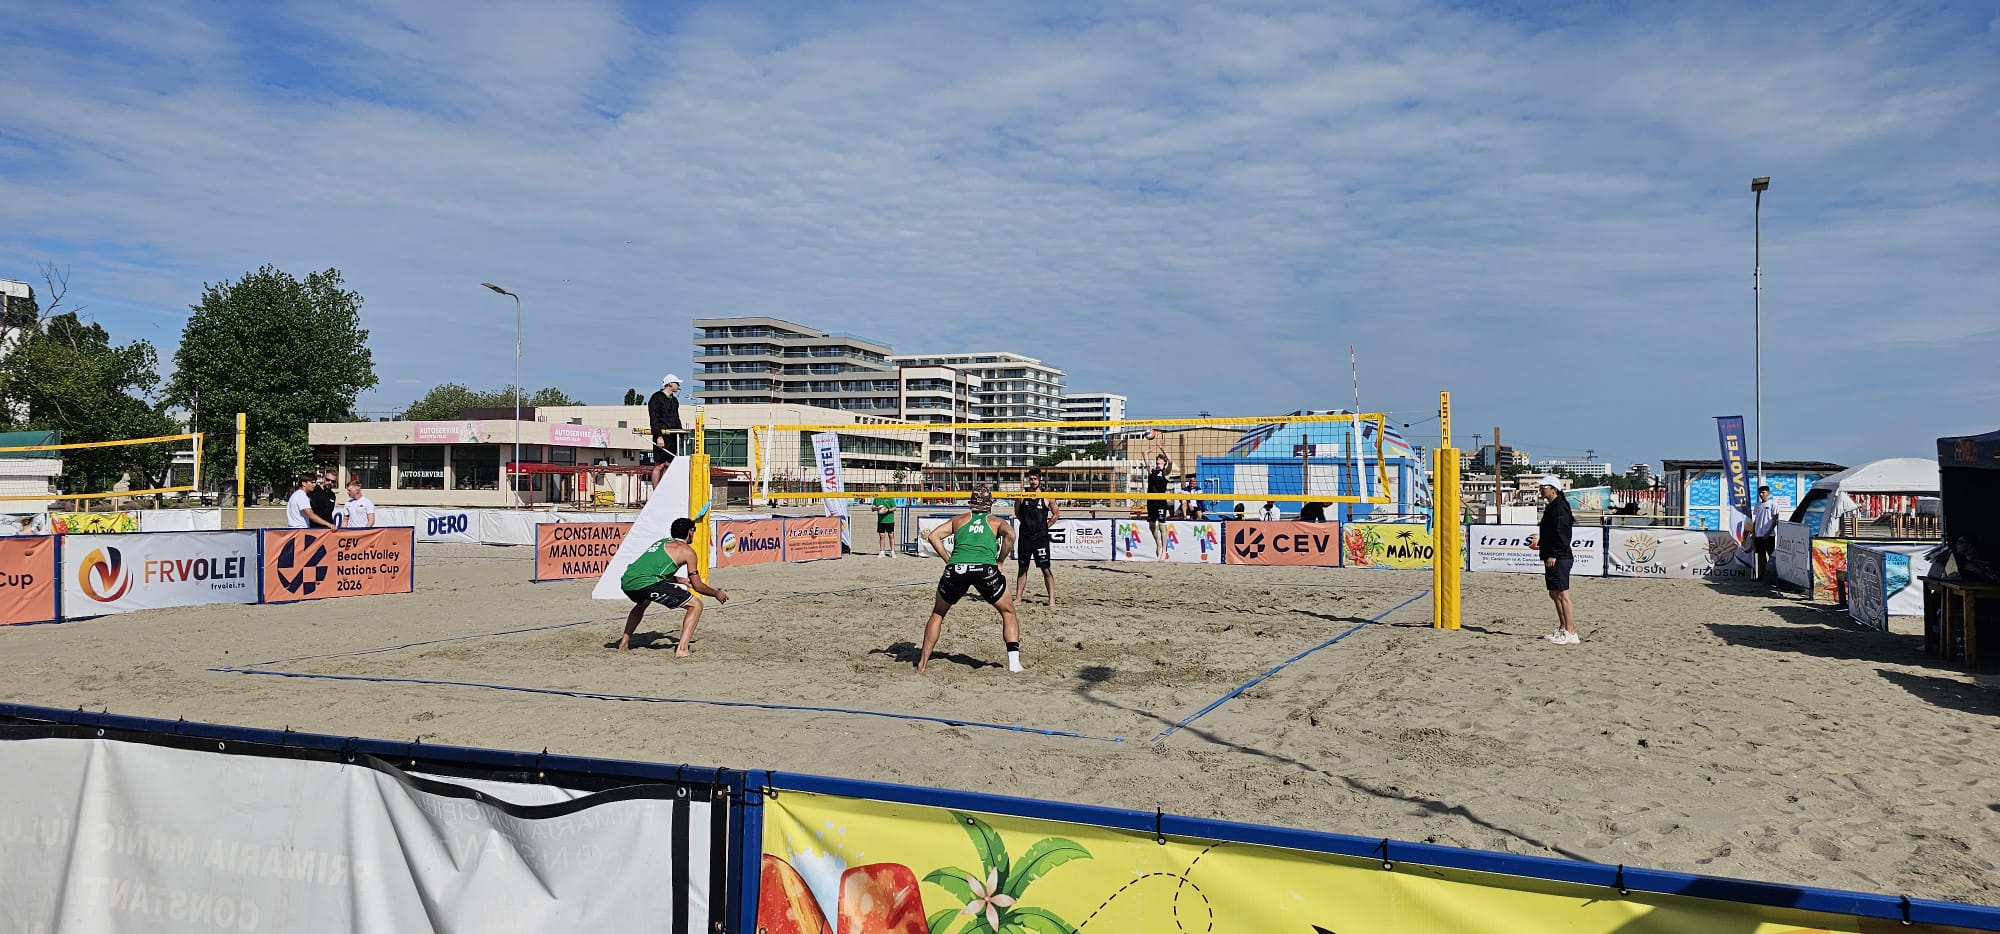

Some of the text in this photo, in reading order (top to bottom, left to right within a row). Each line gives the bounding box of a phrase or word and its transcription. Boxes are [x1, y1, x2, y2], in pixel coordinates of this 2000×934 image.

[427, 513, 468, 536] DERO
[554, 527, 620, 540] CONSTANTA
[338, 538, 360, 548] CEV
[1273, 534, 1330, 553] CEV
[337, 549, 400, 561] BeachVolley
[549, 544, 619, 558] MANOBEAC
[144, 556, 246, 583] FRVOLEI
[337, 564, 400, 576] Nations Cup
[1615, 565, 1666, 574] FIZIOSUN
[1692, 568, 1746, 576] FIZIOSUN
[211, 582, 246, 590] frvolei.ro
[337, 580, 362, 591] 2026
